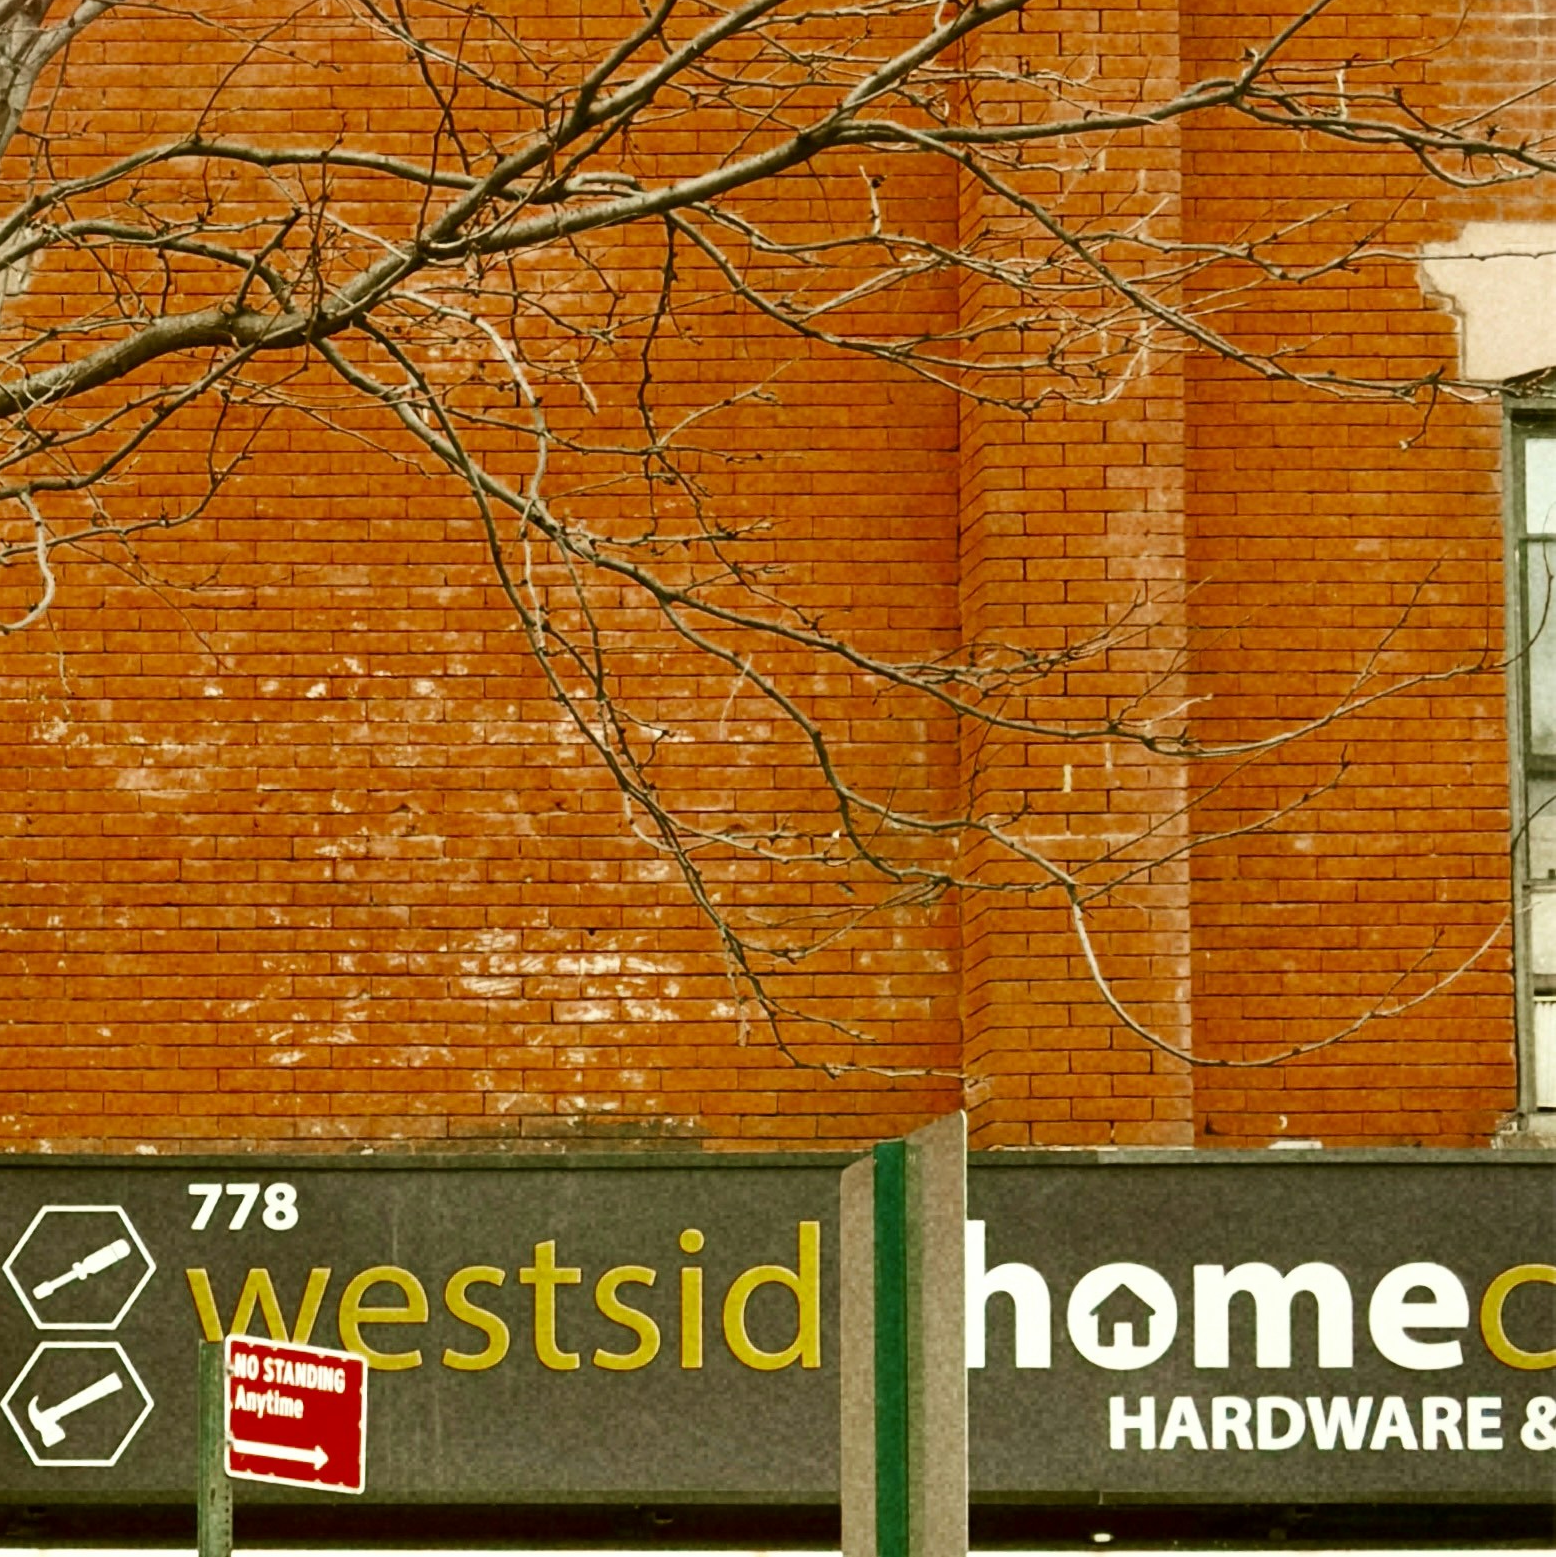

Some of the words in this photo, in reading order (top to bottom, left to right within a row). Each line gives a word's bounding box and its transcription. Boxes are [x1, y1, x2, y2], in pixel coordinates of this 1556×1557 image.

[188, 1183, 299, 1230] 778
[186, 1220, 821, 1372] westsid
[234, 1353, 259, 1380] NO
[263, 1357, 346, 1394] STANDING
[235, 1384, 304, 1419] Anytime
[1109, 1395, 1504, 1451] HARDWARE
[1520, 1395, 1556, 1451] &
